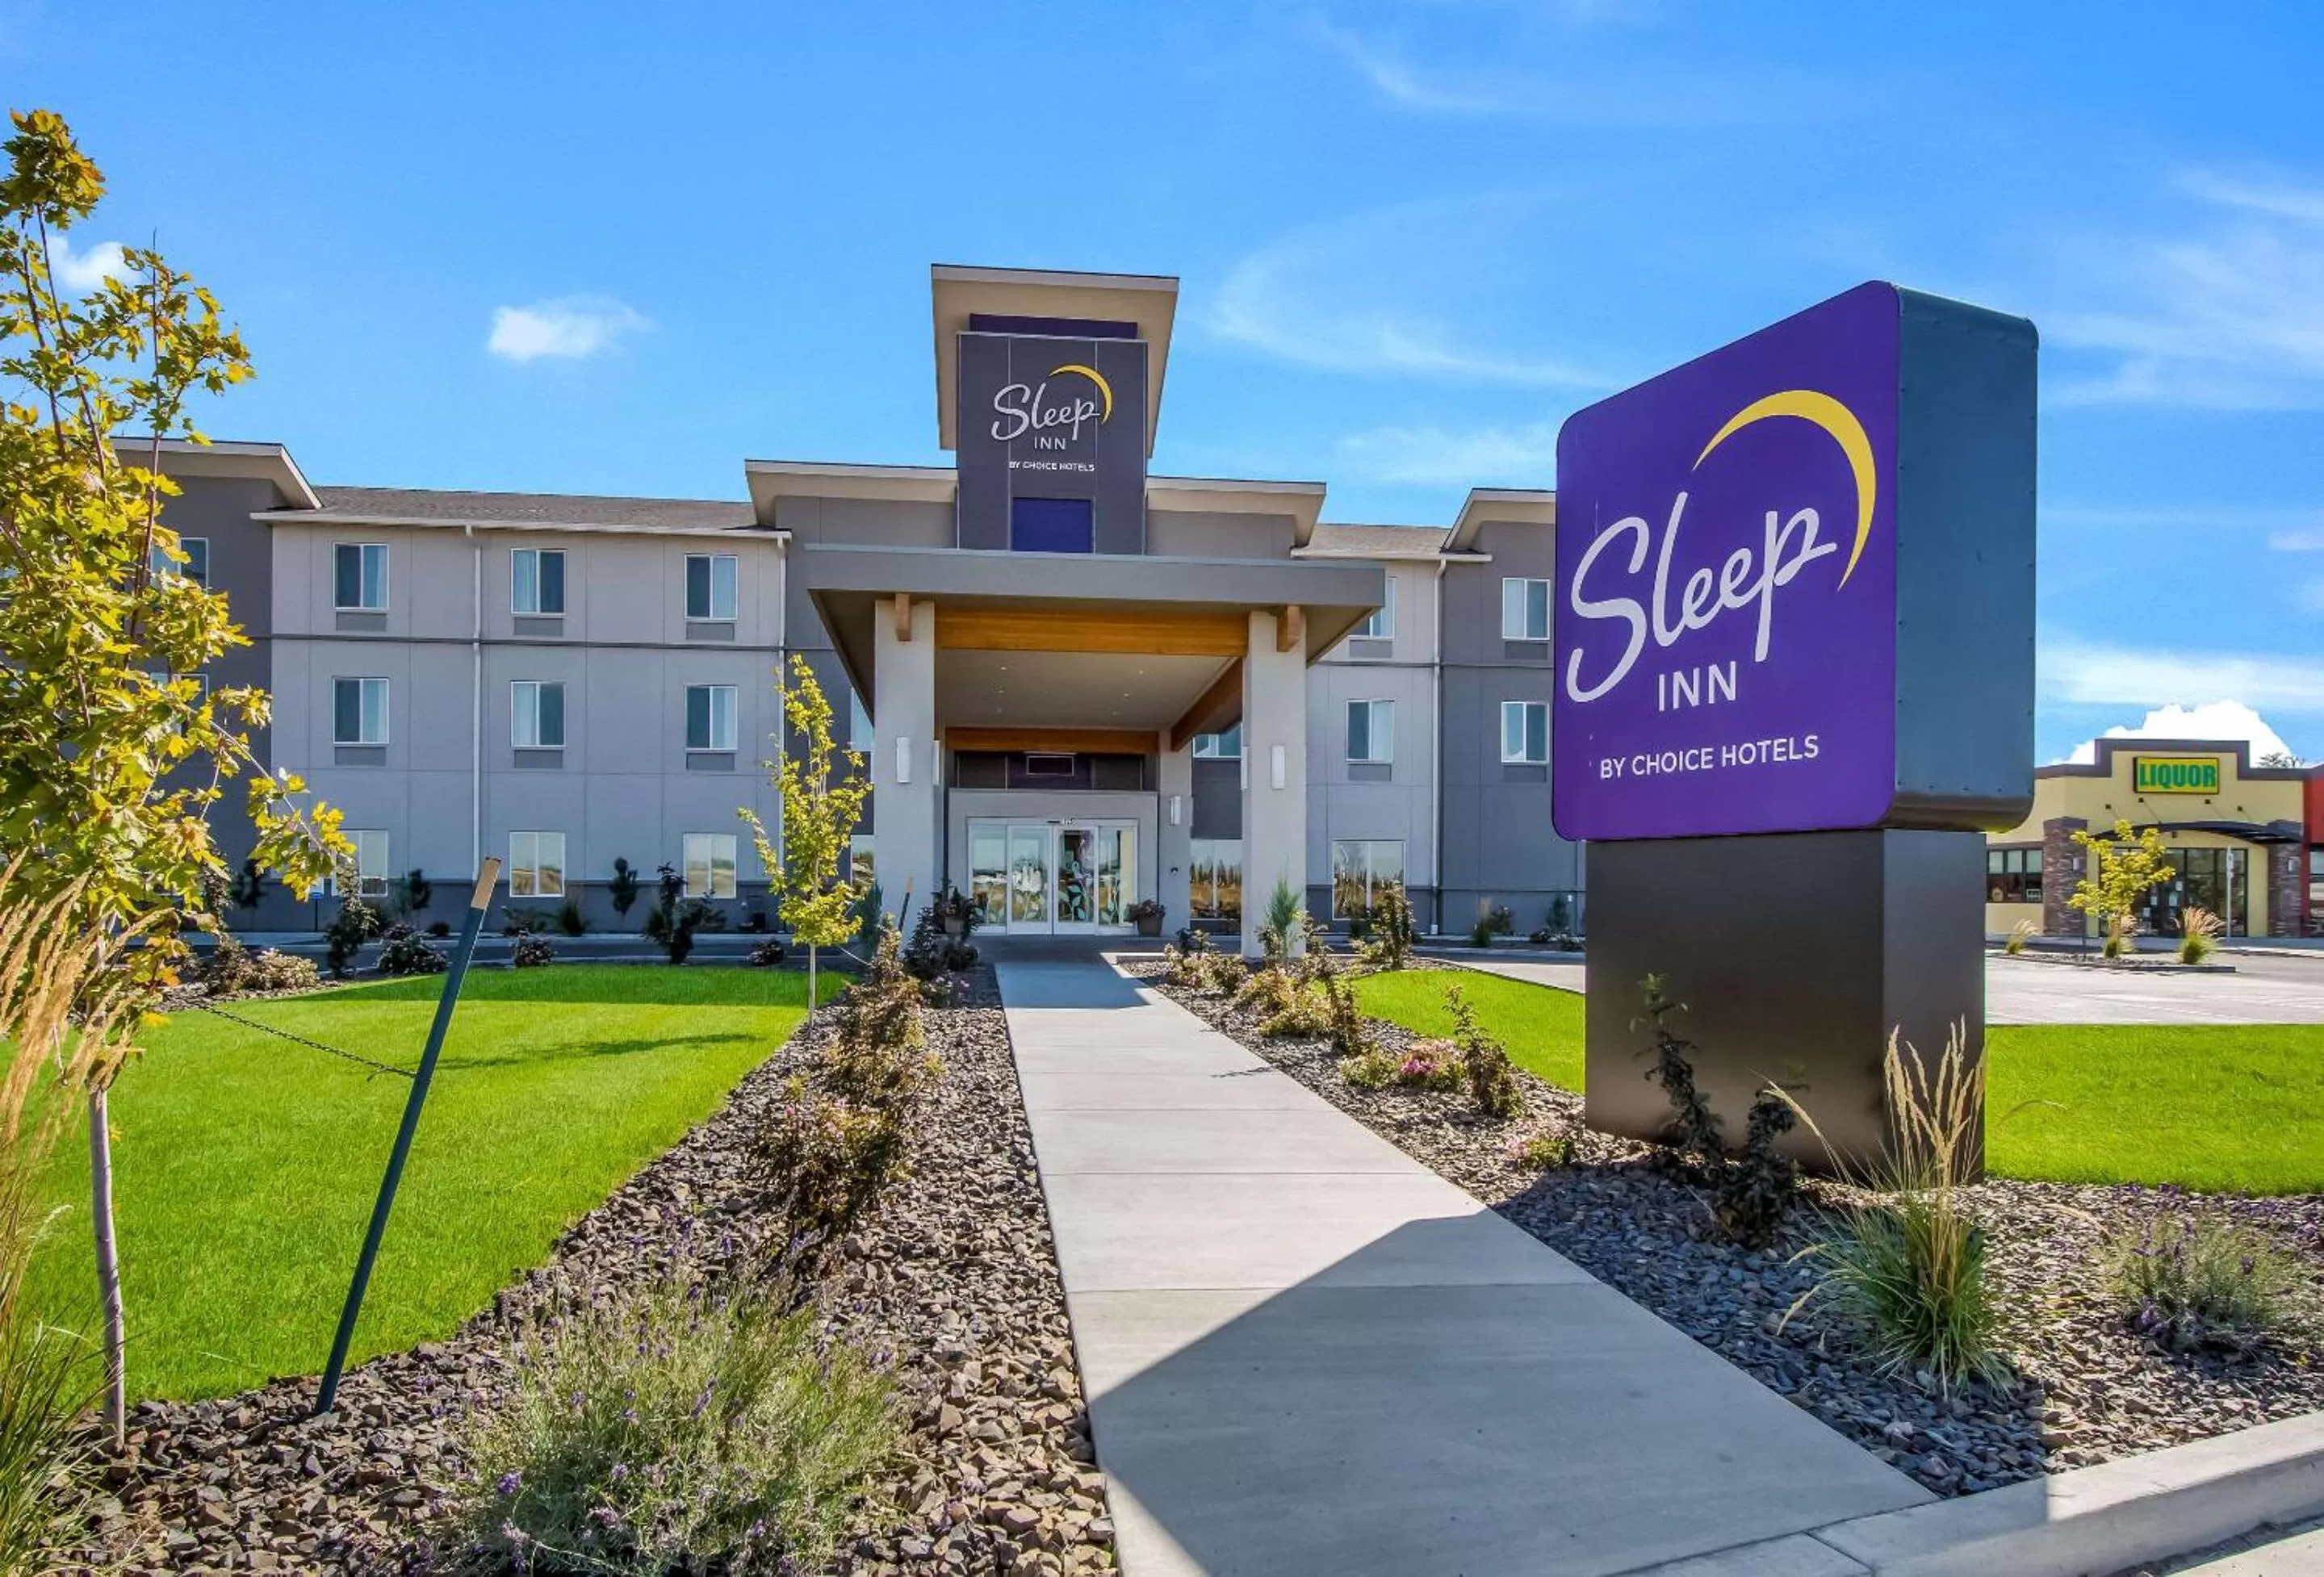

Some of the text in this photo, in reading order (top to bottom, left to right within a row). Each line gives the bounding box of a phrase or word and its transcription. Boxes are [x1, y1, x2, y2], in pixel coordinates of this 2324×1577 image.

[991, 382, 1100, 441] Sleep
[1009, 461, 1095, 471] BY CHOICE HOTELS
[1034, 436, 1066, 450] INN
[1566, 492, 1837, 702] Sleep
[1659, 661, 1736, 712] INN
[1601, 734, 1819, 780] BY CHOICE HOTELS
[2139, 763, 2217, 788] LIQUOR
